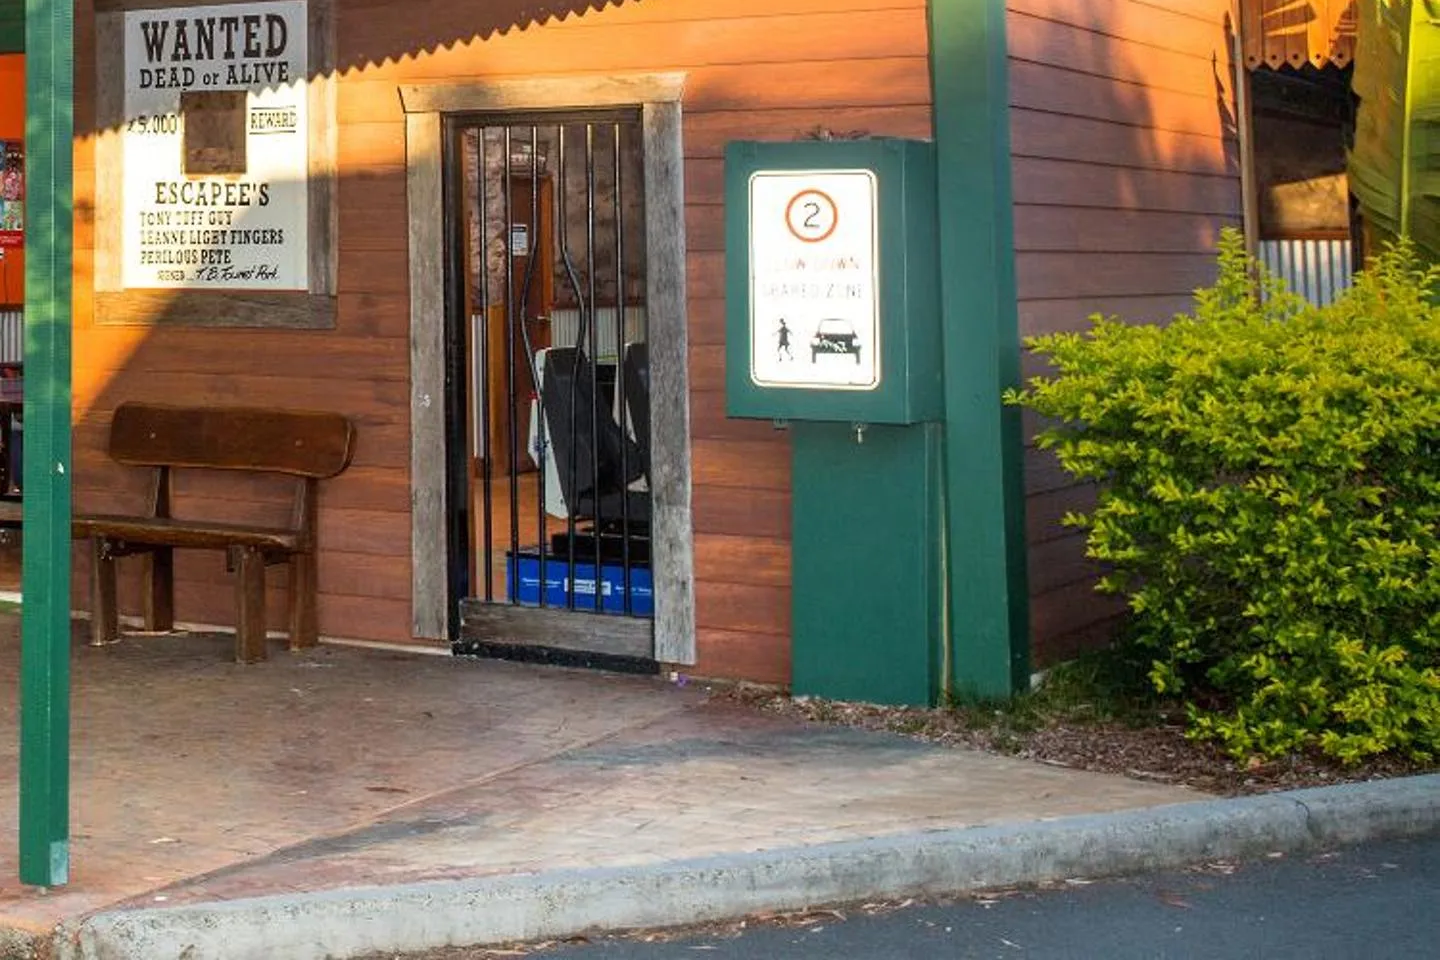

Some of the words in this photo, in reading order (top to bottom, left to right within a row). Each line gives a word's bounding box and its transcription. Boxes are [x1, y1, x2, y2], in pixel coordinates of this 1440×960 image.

[140, 13, 289, 62] WANTED
[139, 67, 195, 89] DEAD
[202, 71, 219, 85] or
[226, 61, 289, 84] ALIVE
[250, 112, 298, 130] REWARD
[155, 182, 270, 207] ESCAPEE'S
[803, 202, 821, 228] 2
[230, 228, 285, 245] FINGERS
[201, 249, 232, 265] PETE
